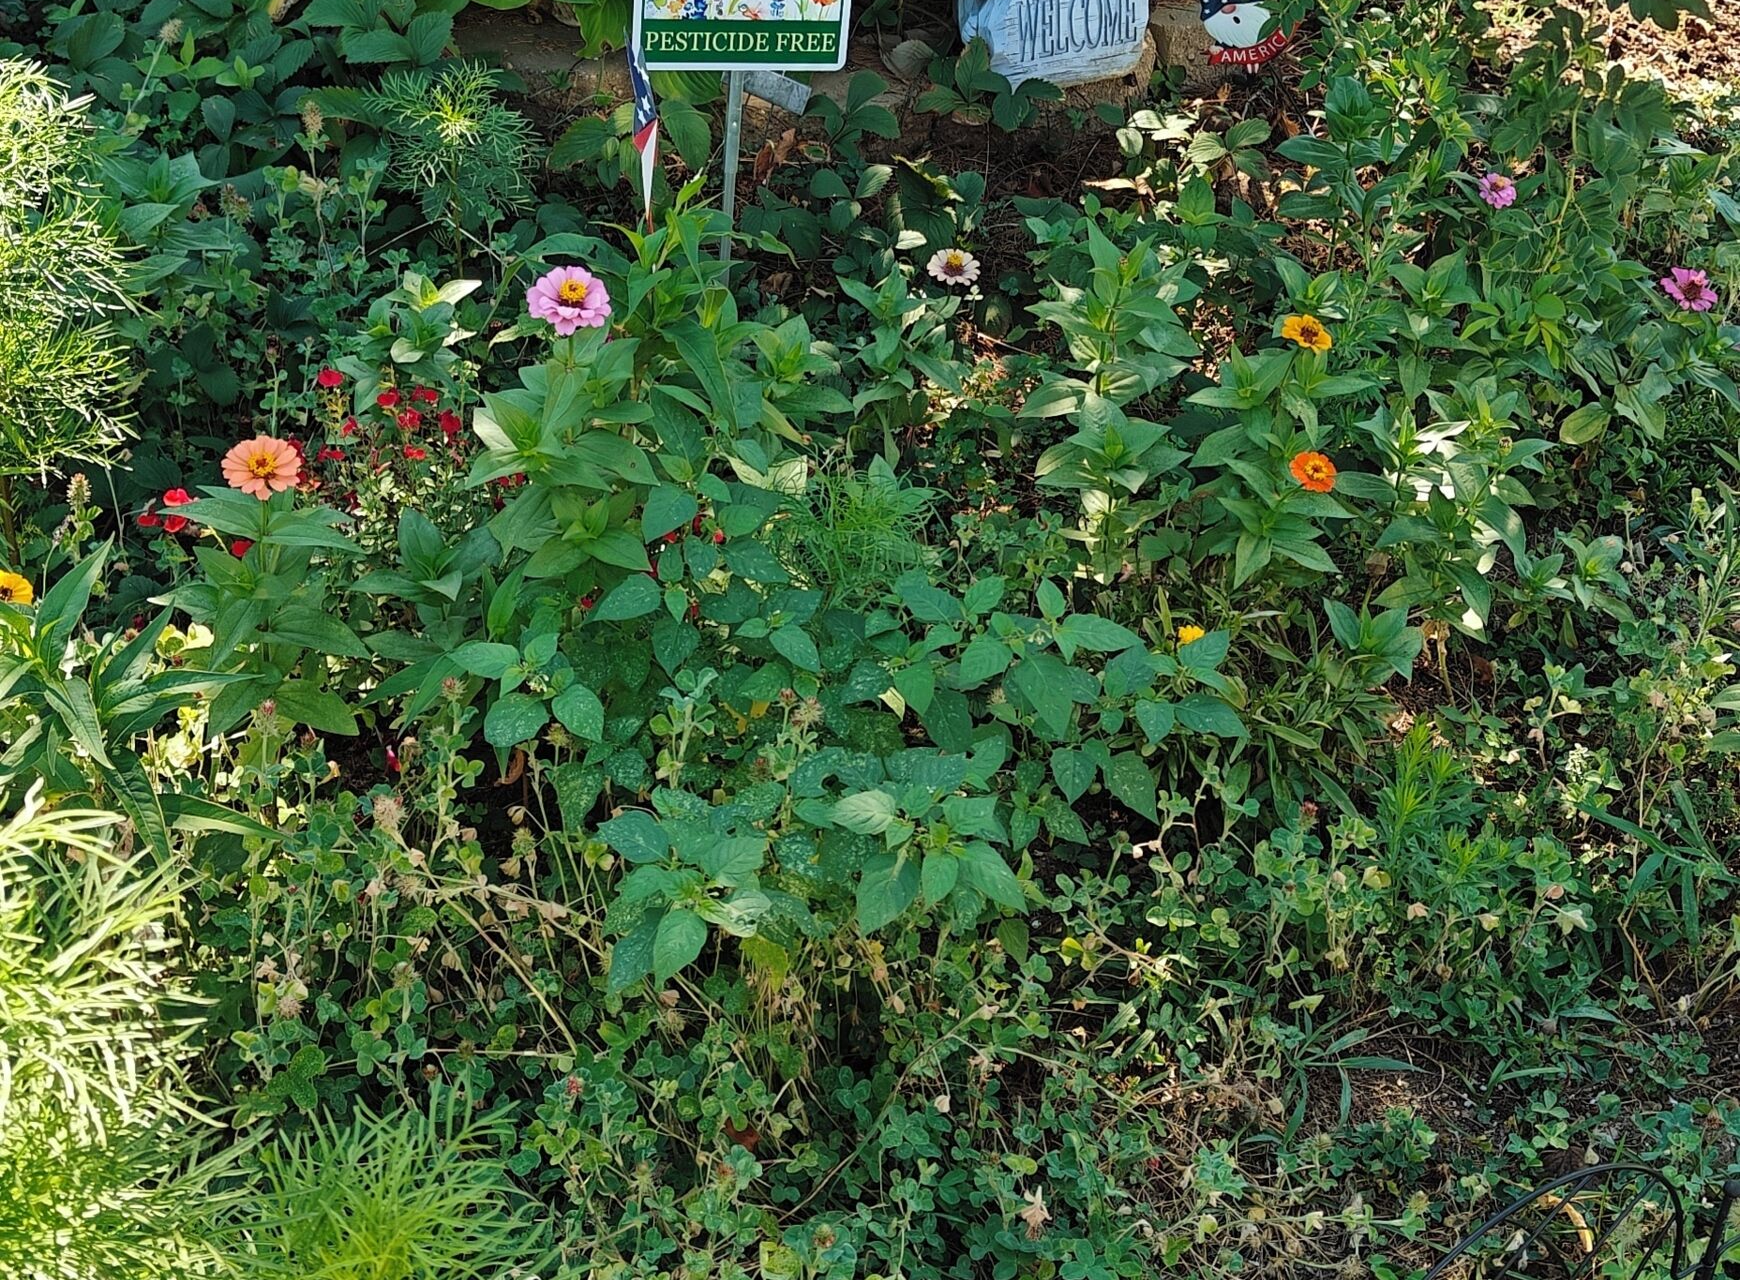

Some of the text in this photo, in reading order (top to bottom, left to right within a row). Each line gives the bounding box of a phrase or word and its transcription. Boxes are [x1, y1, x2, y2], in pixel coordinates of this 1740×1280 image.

[645, 31, 836, 52] PESTICIDE FREE
[1221, 30, 1289, 63] AMERIC
